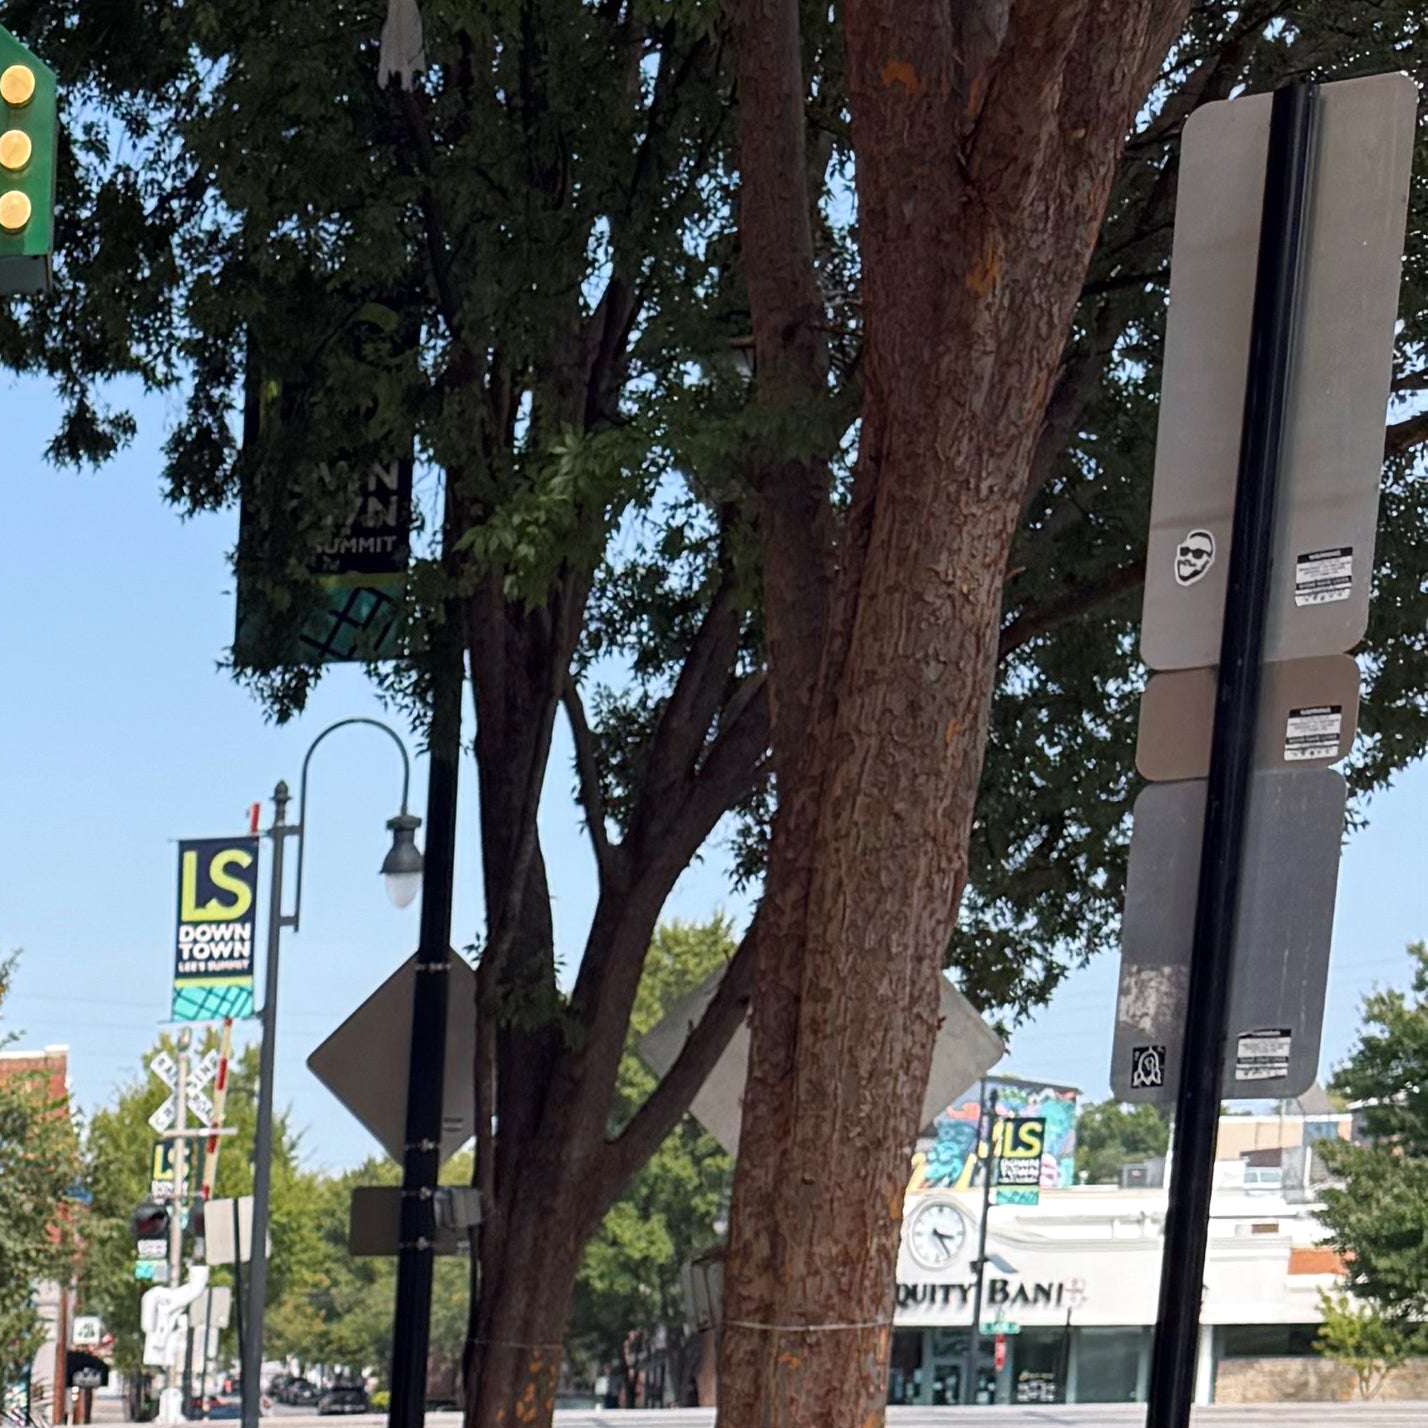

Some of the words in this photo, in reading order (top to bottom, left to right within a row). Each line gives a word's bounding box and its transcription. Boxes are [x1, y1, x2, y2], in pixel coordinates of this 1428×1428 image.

[181, 849, 254, 922] LS
[179, 923, 251, 942] DOWN
[178, 941, 250, 960] TOWN
[1003, 1121, 1043, 1158] LS
[897, 1283, 973, 1307] QUITY
